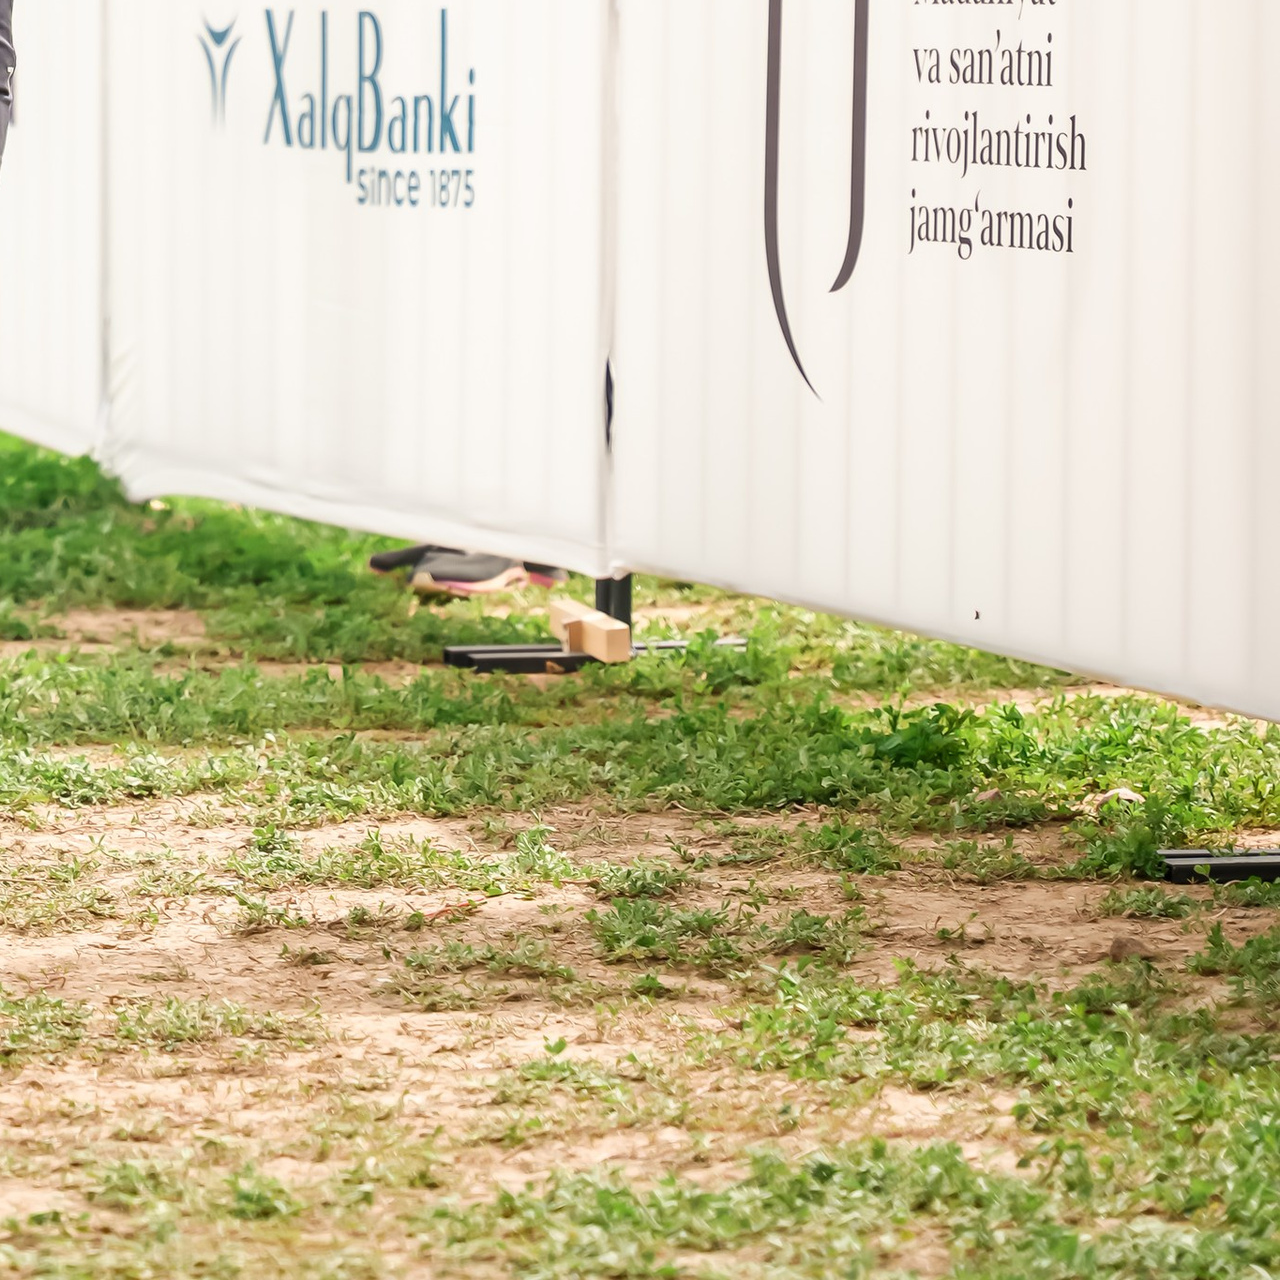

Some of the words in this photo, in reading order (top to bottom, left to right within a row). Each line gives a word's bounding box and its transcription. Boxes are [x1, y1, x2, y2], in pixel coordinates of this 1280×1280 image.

[912, 47, 942, 85] va
[263, 7, 476, 185] XalqBanki
[910, 109, 1088, 179] rivojlantirish
[355, 165, 422, 207] since
[429, 167, 476, 209] 1875
